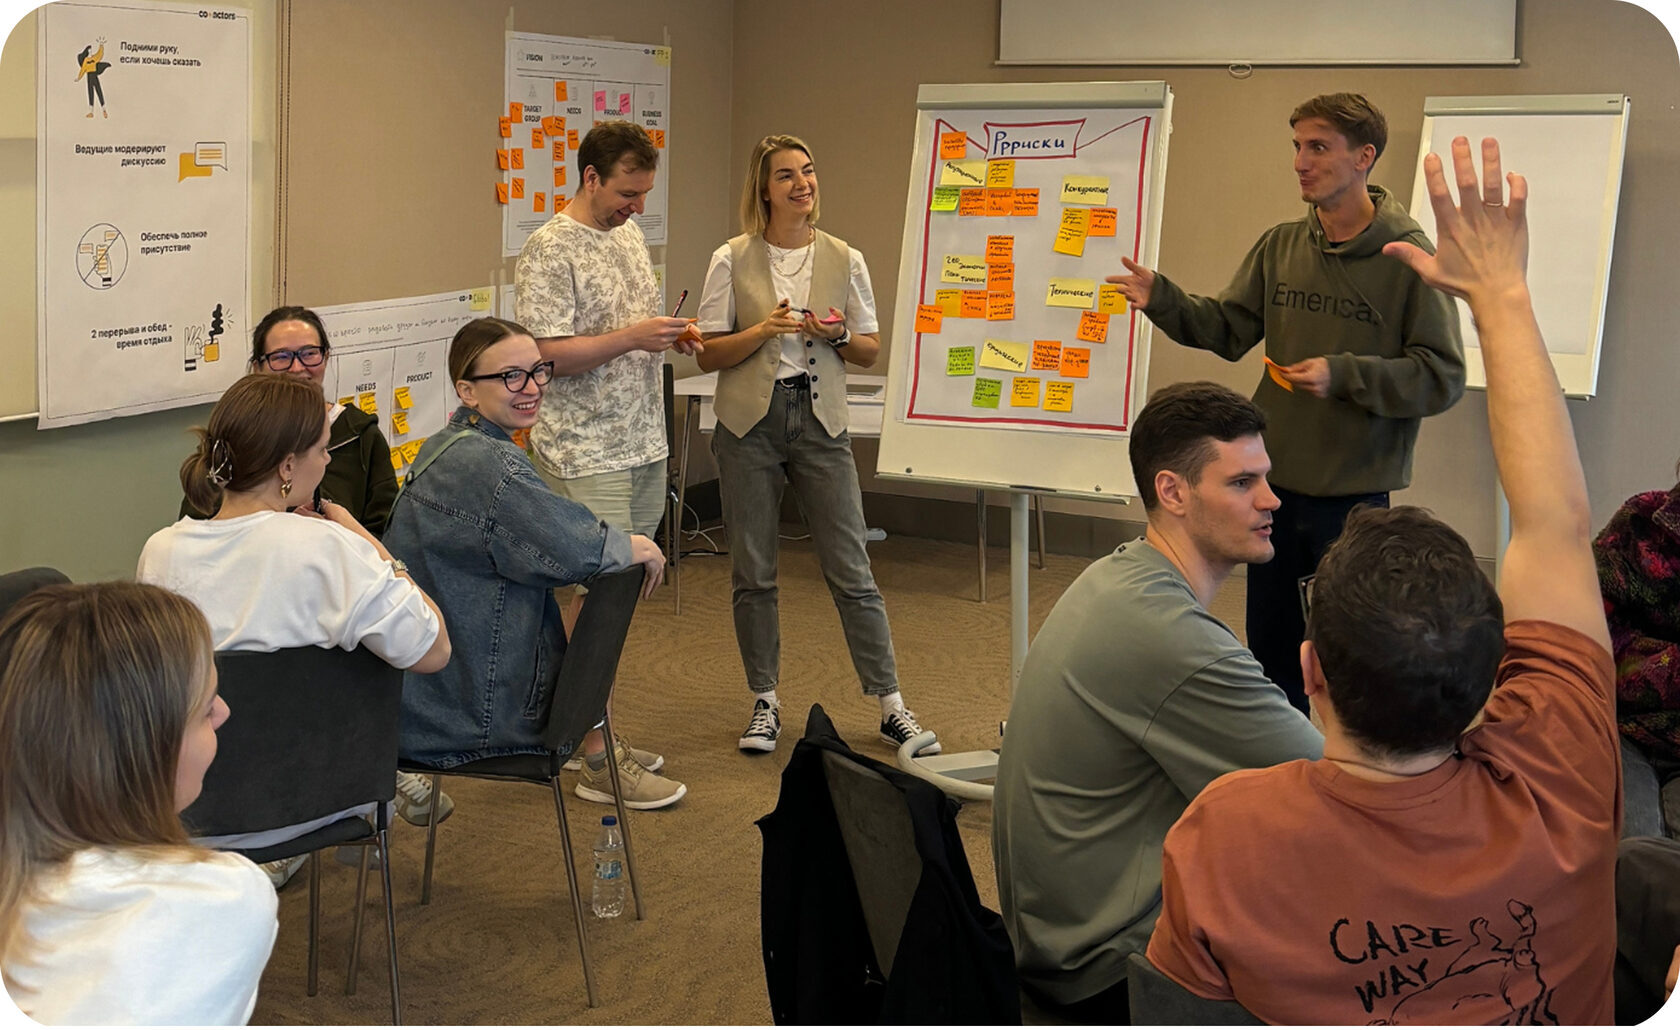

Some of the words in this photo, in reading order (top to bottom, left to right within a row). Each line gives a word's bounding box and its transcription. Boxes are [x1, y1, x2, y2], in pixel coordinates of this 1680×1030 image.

[120, 41, 158, 53] Подними
[159, 44, 180, 55] руку,
[120, 56, 140, 64] если
[141, 57, 171, 67] хочешь
[172, 58, 202, 68] сказать
[524, 105, 542, 113] TARGET
[603, 108, 624, 116] PRODUC
[524, 115, 541, 123] GROUP
[75, 144, 113, 155] Ведущие
[114, 144, 166, 155] модерируют
[993, 131, 1065, 156] Ррриски
[121, 156, 166, 168] дискуссию
[140, 231, 179, 242] Обеспечь
[180, 230, 208, 240] полное
[140, 243, 191, 255] присутствие
[91, 329, 97, 339] 2
[98, 327, 140, 338] перерыва
[141, 326, 147, 334] и
[147, 323, 168, 334] обед
[116, 339, 142, 350] время
[143, 335, 173, 347] отдыха
[406, 371, 433, 383] PRODUCT
[355, 382, 377, 393] NEEDS
[1330, 918, 1461, 964] CARE
[1355, 958, 1429, 1013] WAY
